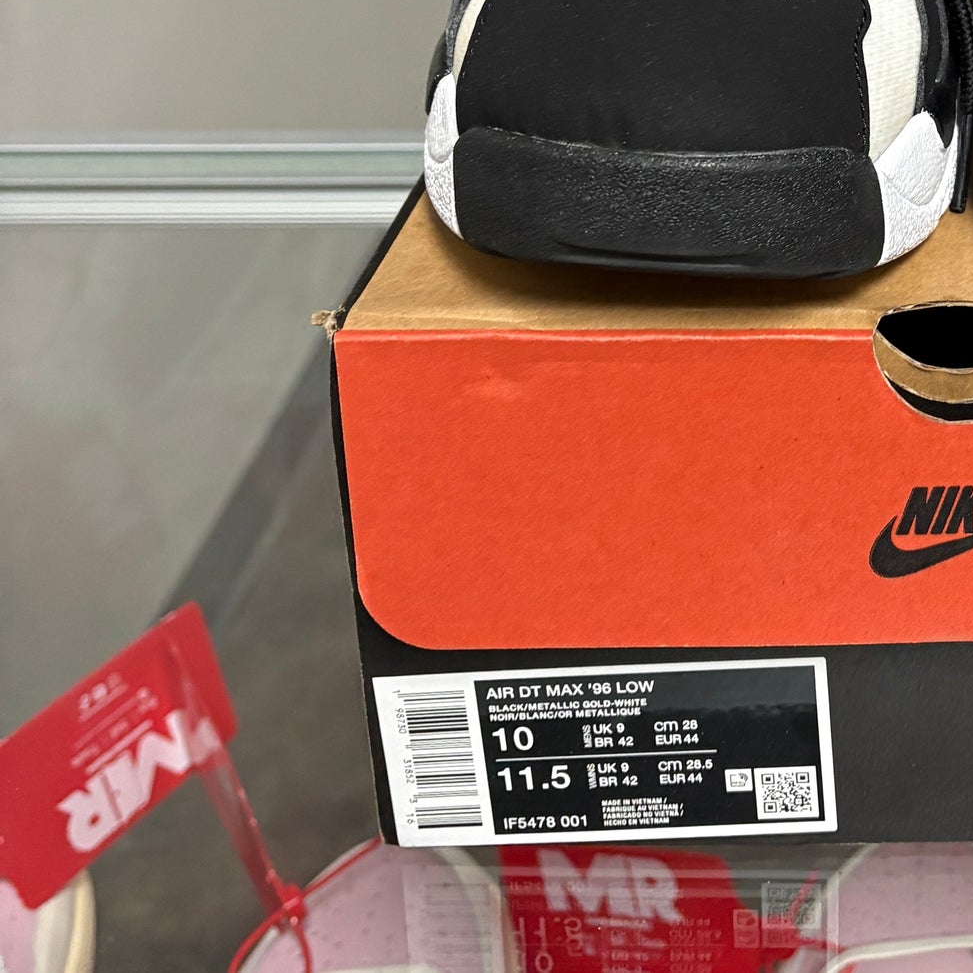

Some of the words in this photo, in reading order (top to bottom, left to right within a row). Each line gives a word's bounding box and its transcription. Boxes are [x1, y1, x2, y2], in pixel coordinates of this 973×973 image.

[485, 686, 515, 700] AIR
[519, 685, 541, 698] DT
[546, 683, 584, 697] MAX
[588, 682, 612, 695] '96
[616, 680, 655, 694] LOW
[488, 700, 580, 713] BLACK/METALLIC
[582, 698, 648, 709] GOLD-WHITE
[489, 709, 573, 722] NOIR/BLANC/OR
[575, 707, 641, 718] METALLIQUE
[592, 723, 613, 734] UK
[616, 722, 625, 733] 9
[682, 719, 698, 730] 28
[491, 726, 534, 752] 10
[594, 737, 614, 748] BR
[618, 736, 634, 747] 42
[655, 733, 682, 746] EUR
[683, 733, 699, 744] 44
[597, 762, 618, 774] UK
[620, 762, 630, 773] 9
[686, 758, 713, 770] 28.5
[57, 709, 220, 852] MR
[497, 764, 571, 791] 11.5
[599, 776, 618, 787] BR
[622, 775, 638, 786] 42
[659, 773, 686, 784] EUR
[687, 772, 703, 783] 44
[601, 799, 621, 807] MADE
[631, 797, 663, 805] VIETNAM
[647, 803, 679, 811] VIETNAM
[503, 816, 556, 830] IF5478
[560, 814, 588, 828] 001
[638, 817, 670, 825] VIETNAM
[537, 848, 684, 923] MR
